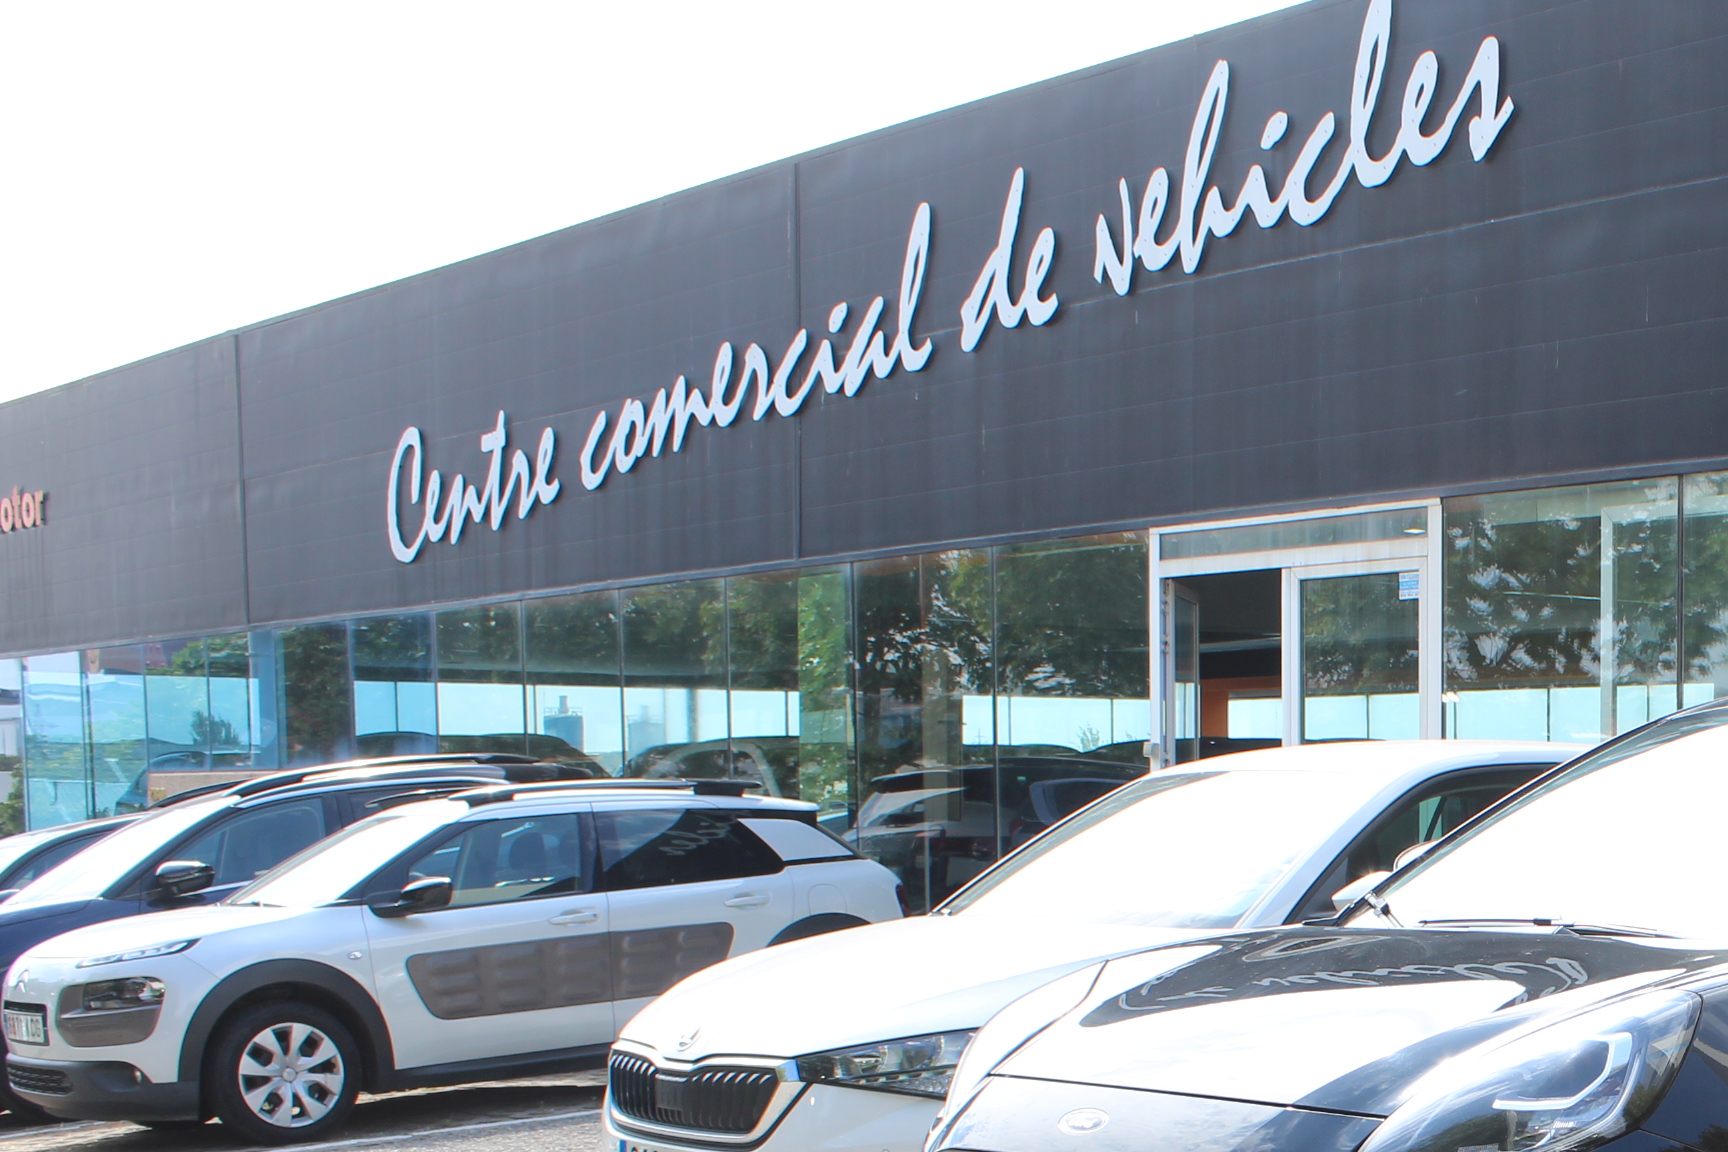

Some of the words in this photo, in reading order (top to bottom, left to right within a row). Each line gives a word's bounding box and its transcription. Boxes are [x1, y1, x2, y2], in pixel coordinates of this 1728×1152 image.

[388, 410, 560, 563] Centre
[580, 202, 933, 491] comercial
[961, 167, 1059, 352] de
[1094, 0, 1514, 297] vehicles
[0, 485, 44, 532] otor
